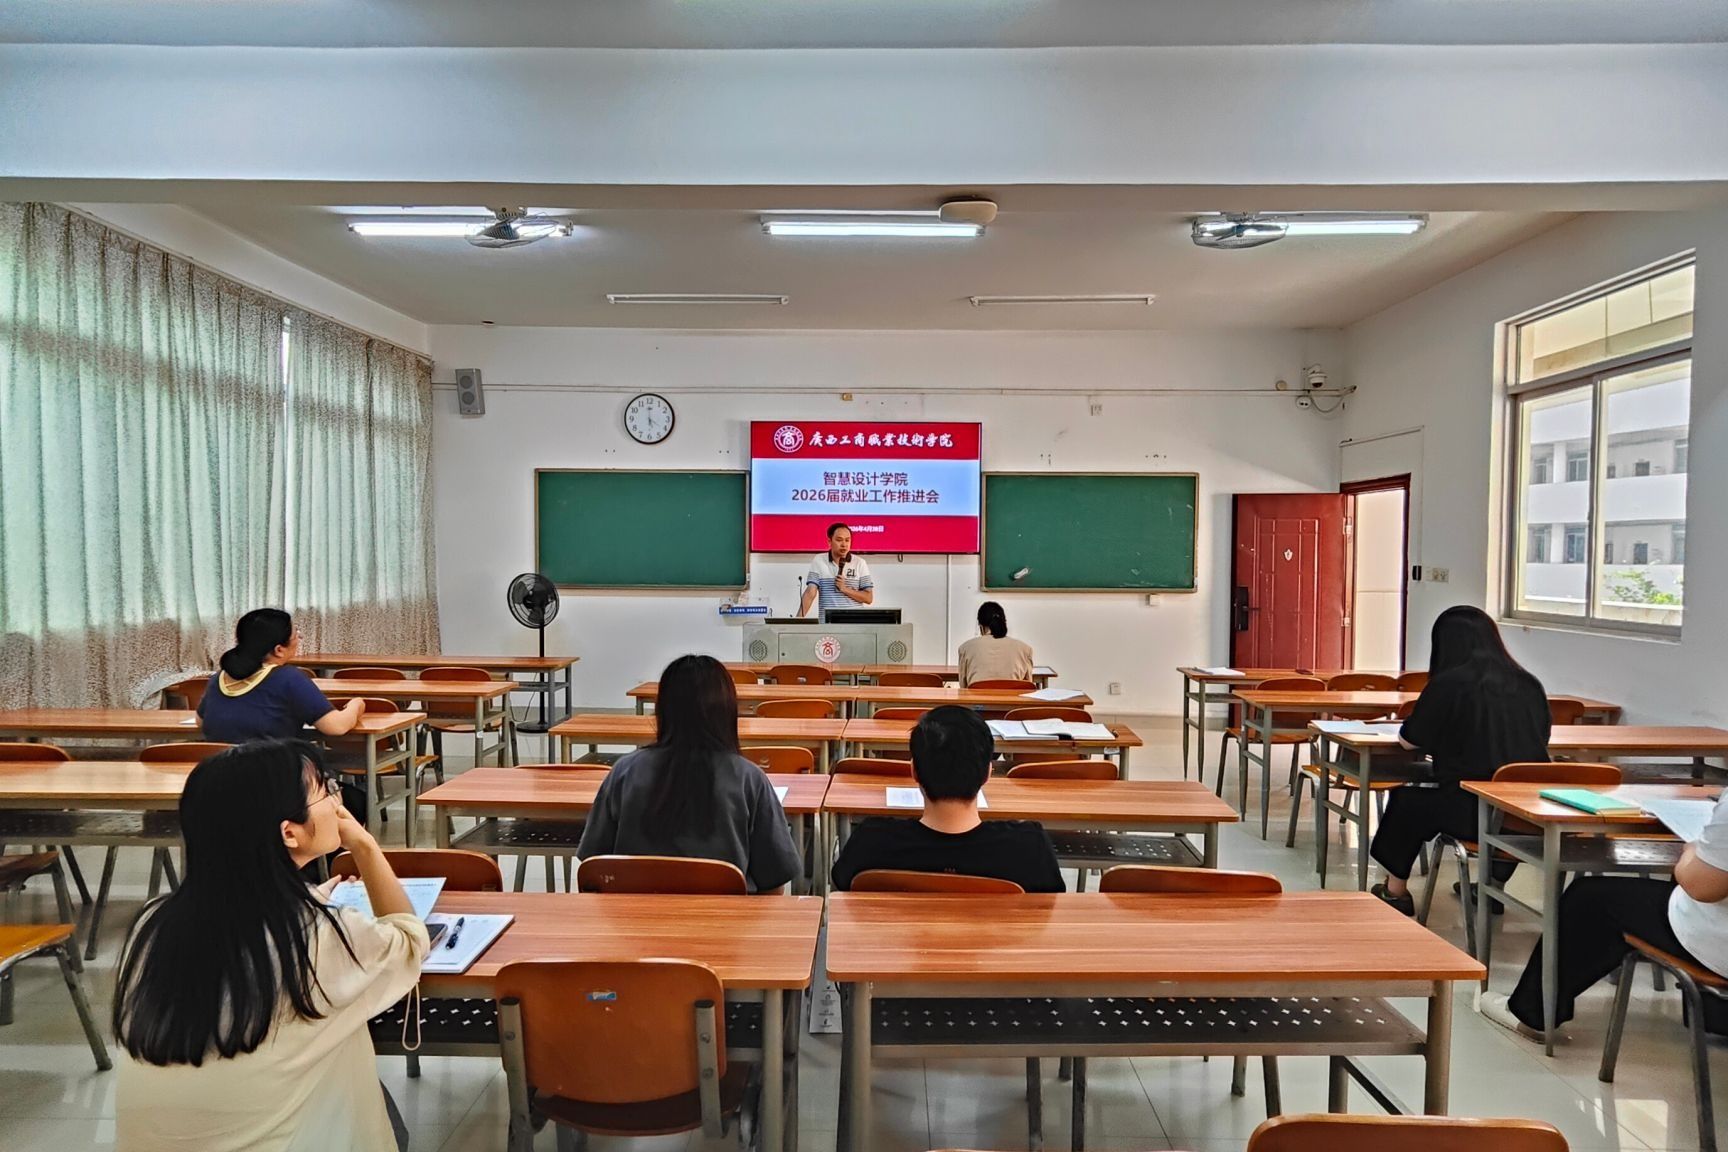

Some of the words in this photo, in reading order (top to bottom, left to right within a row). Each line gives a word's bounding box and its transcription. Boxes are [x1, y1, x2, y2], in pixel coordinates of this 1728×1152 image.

[823, 471, 909, 487] 智慧设计学院
[791, 488, 940, 504] 2026届就业工作推进会
[846, 568, 855, 577] 21
